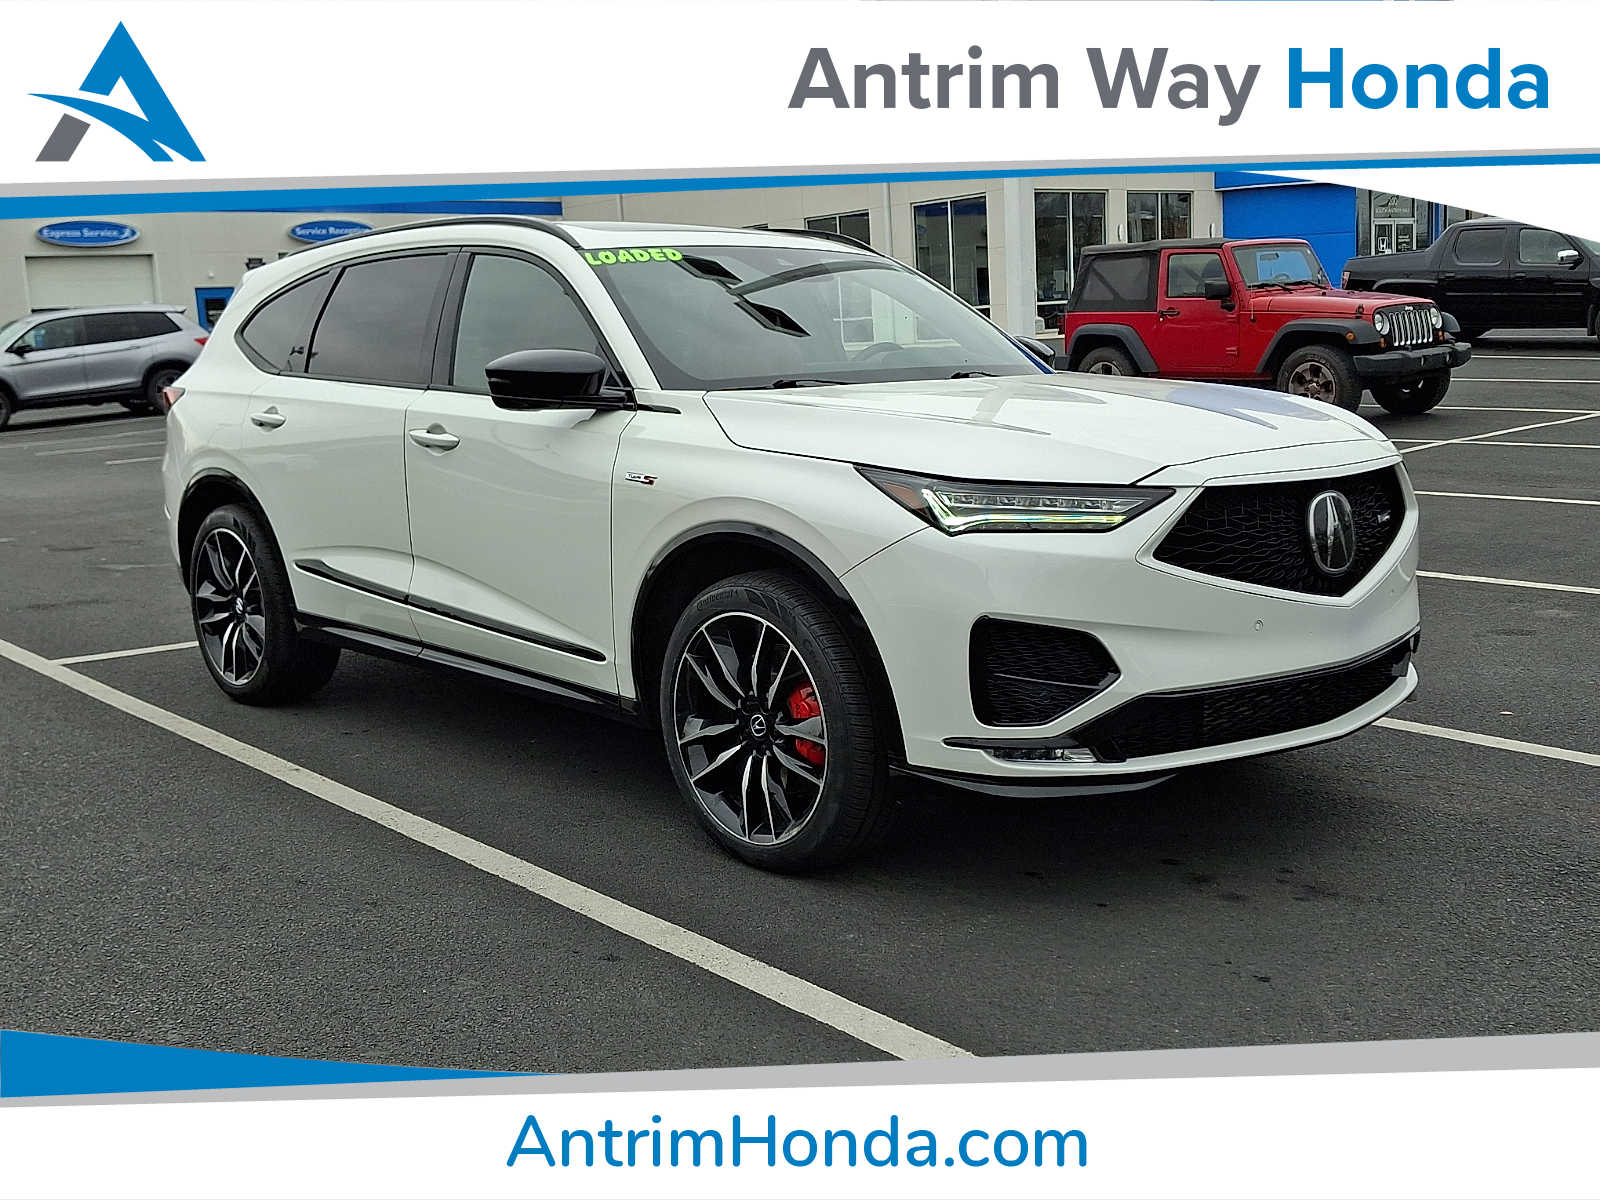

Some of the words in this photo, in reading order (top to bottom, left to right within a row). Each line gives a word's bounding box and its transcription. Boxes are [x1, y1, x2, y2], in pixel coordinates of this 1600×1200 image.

[42, 228, 80, 240] Express
[82, 227, 118, 238] Service
[295, 226, 327, 235] Service
[584, 247, 684, 266] LOADED
